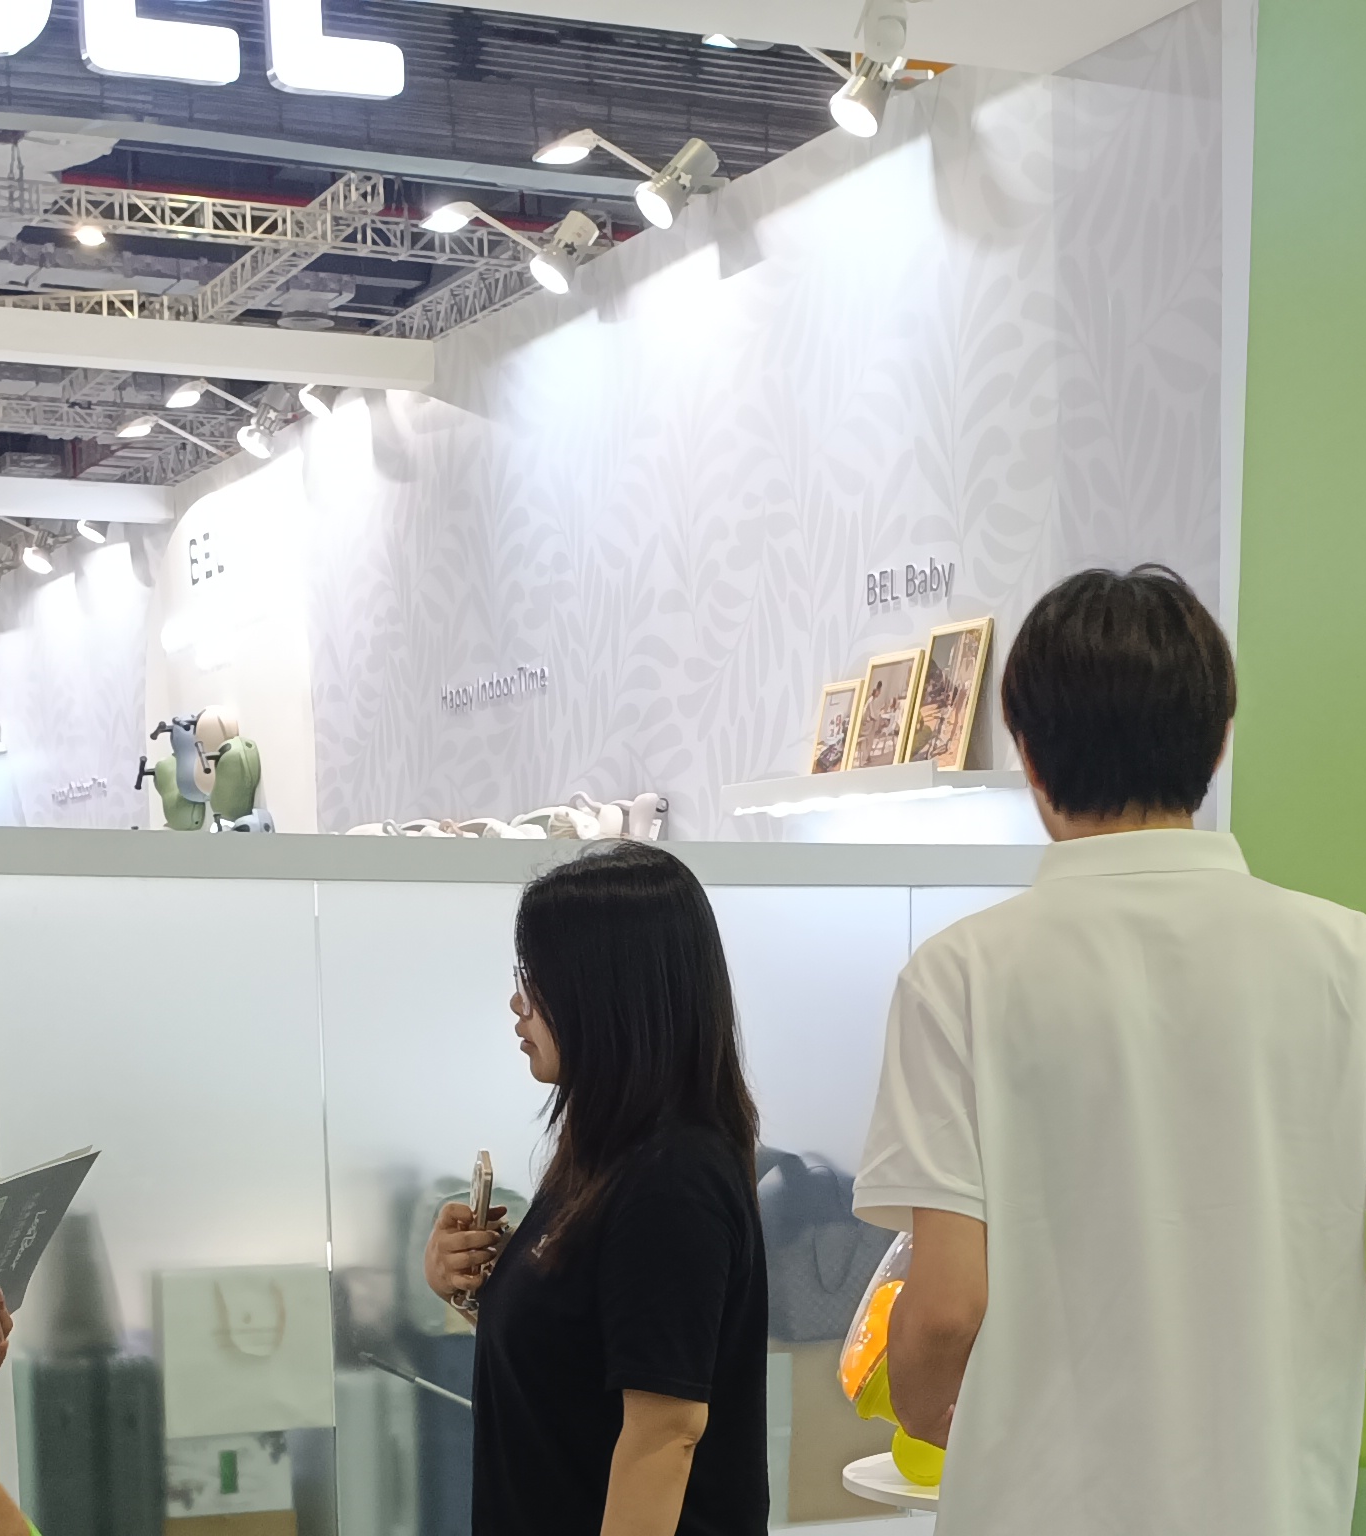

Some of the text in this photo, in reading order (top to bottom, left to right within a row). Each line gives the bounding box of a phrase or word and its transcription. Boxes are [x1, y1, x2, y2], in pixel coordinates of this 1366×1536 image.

[866, 556, 955, 606] BEL Baby
[441, 665, 548, 713] Happy Indoor Time
